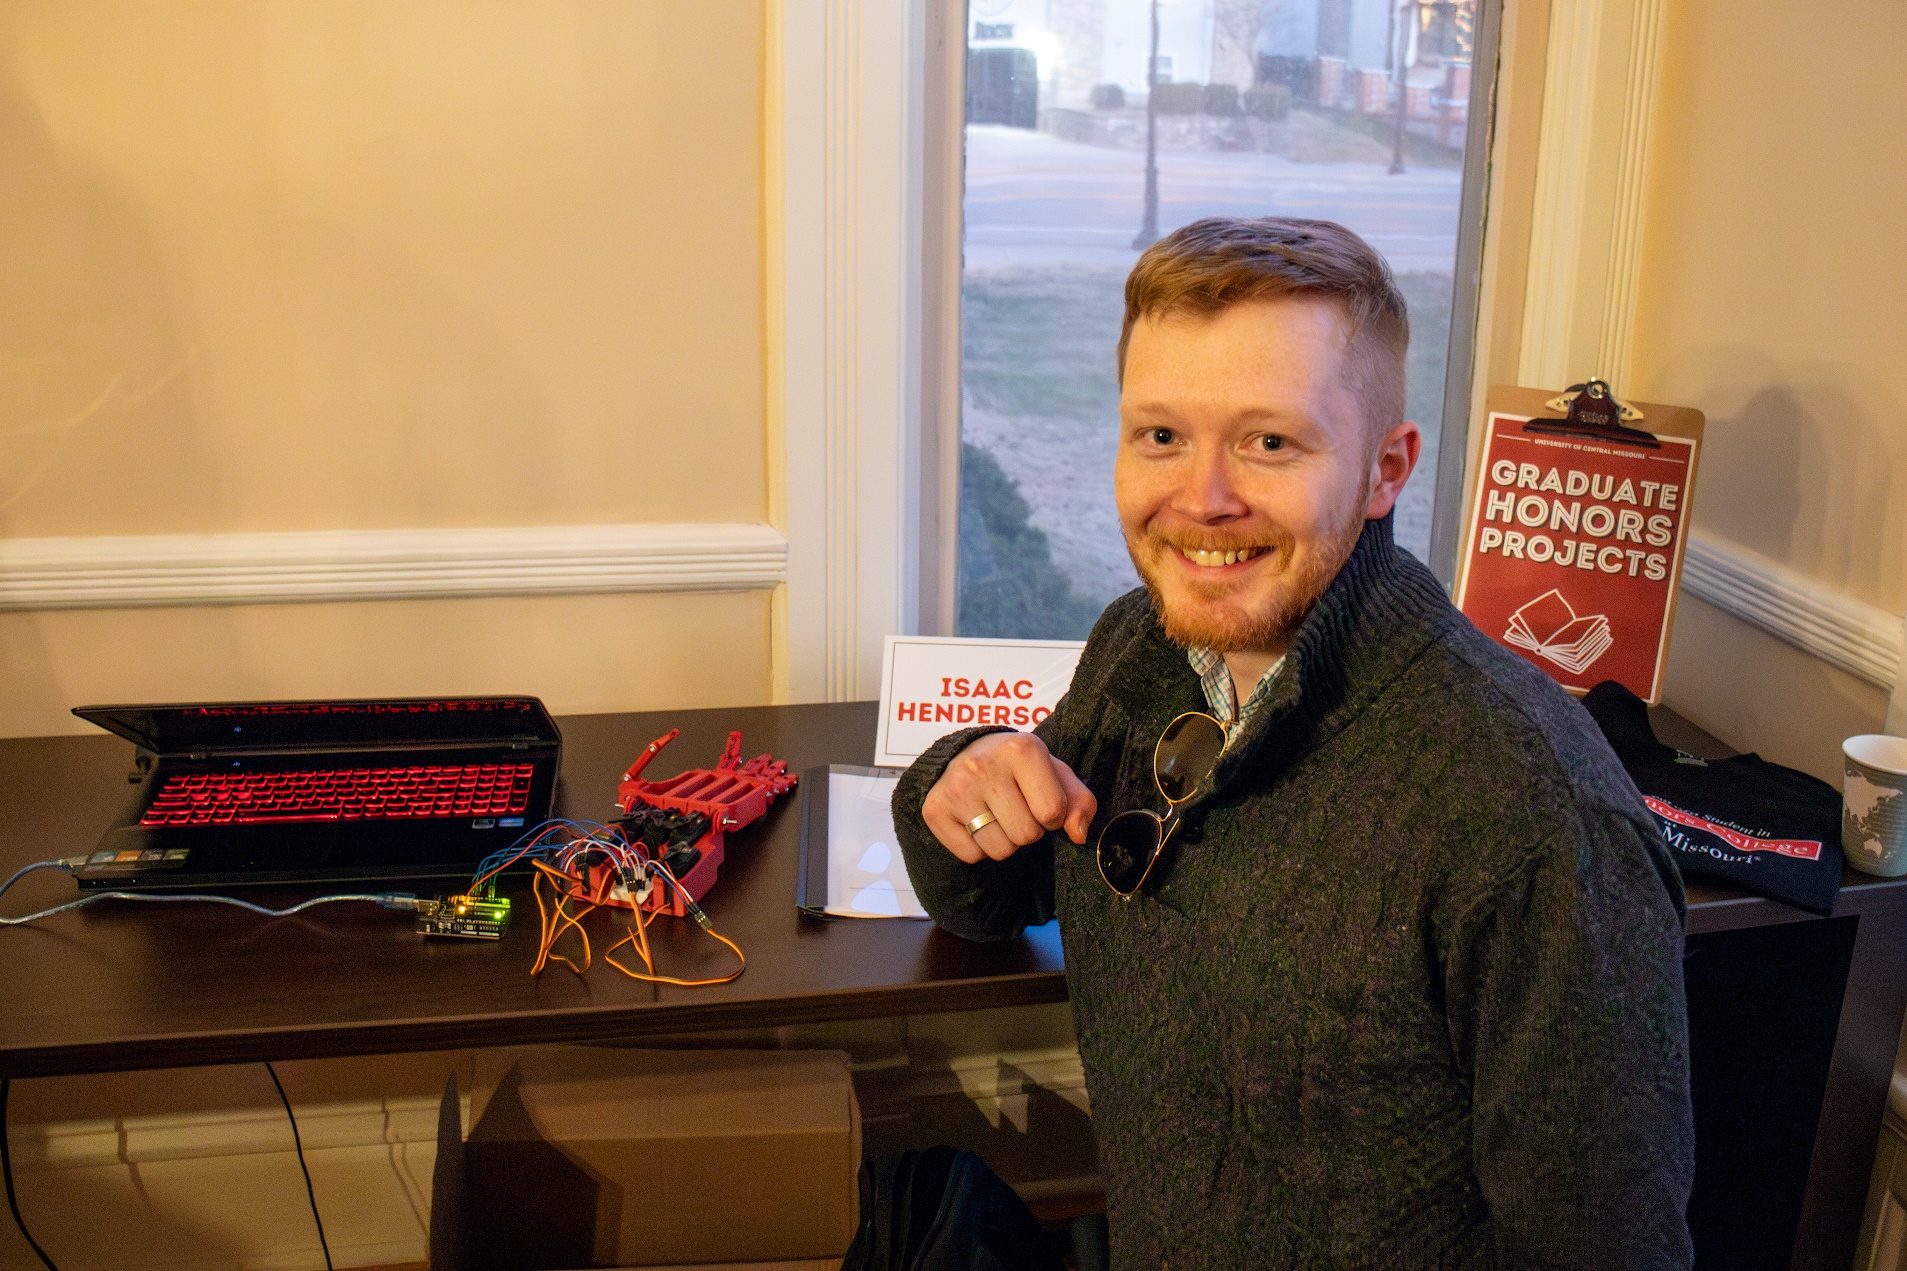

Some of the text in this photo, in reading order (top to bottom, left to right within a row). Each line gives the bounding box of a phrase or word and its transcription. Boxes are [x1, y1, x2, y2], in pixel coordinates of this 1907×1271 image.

[1534, 438, 1572, 449] UNIVERSITY
[1583, 445, 1611, 455] CENTRAL
[1612, 449, 1646, 460] MISSOURI
[1491, 459, 1679, 511] GRADUATE
[1485, 490, 1673, 547] HONORS
[1479, 527, 1667, 581] PROJECTS
[941, 677, 1034, 700] ISAAC
[897, 702, 1053, 726] HENDERSO
[1702, 813, 1771, 838] Student in
